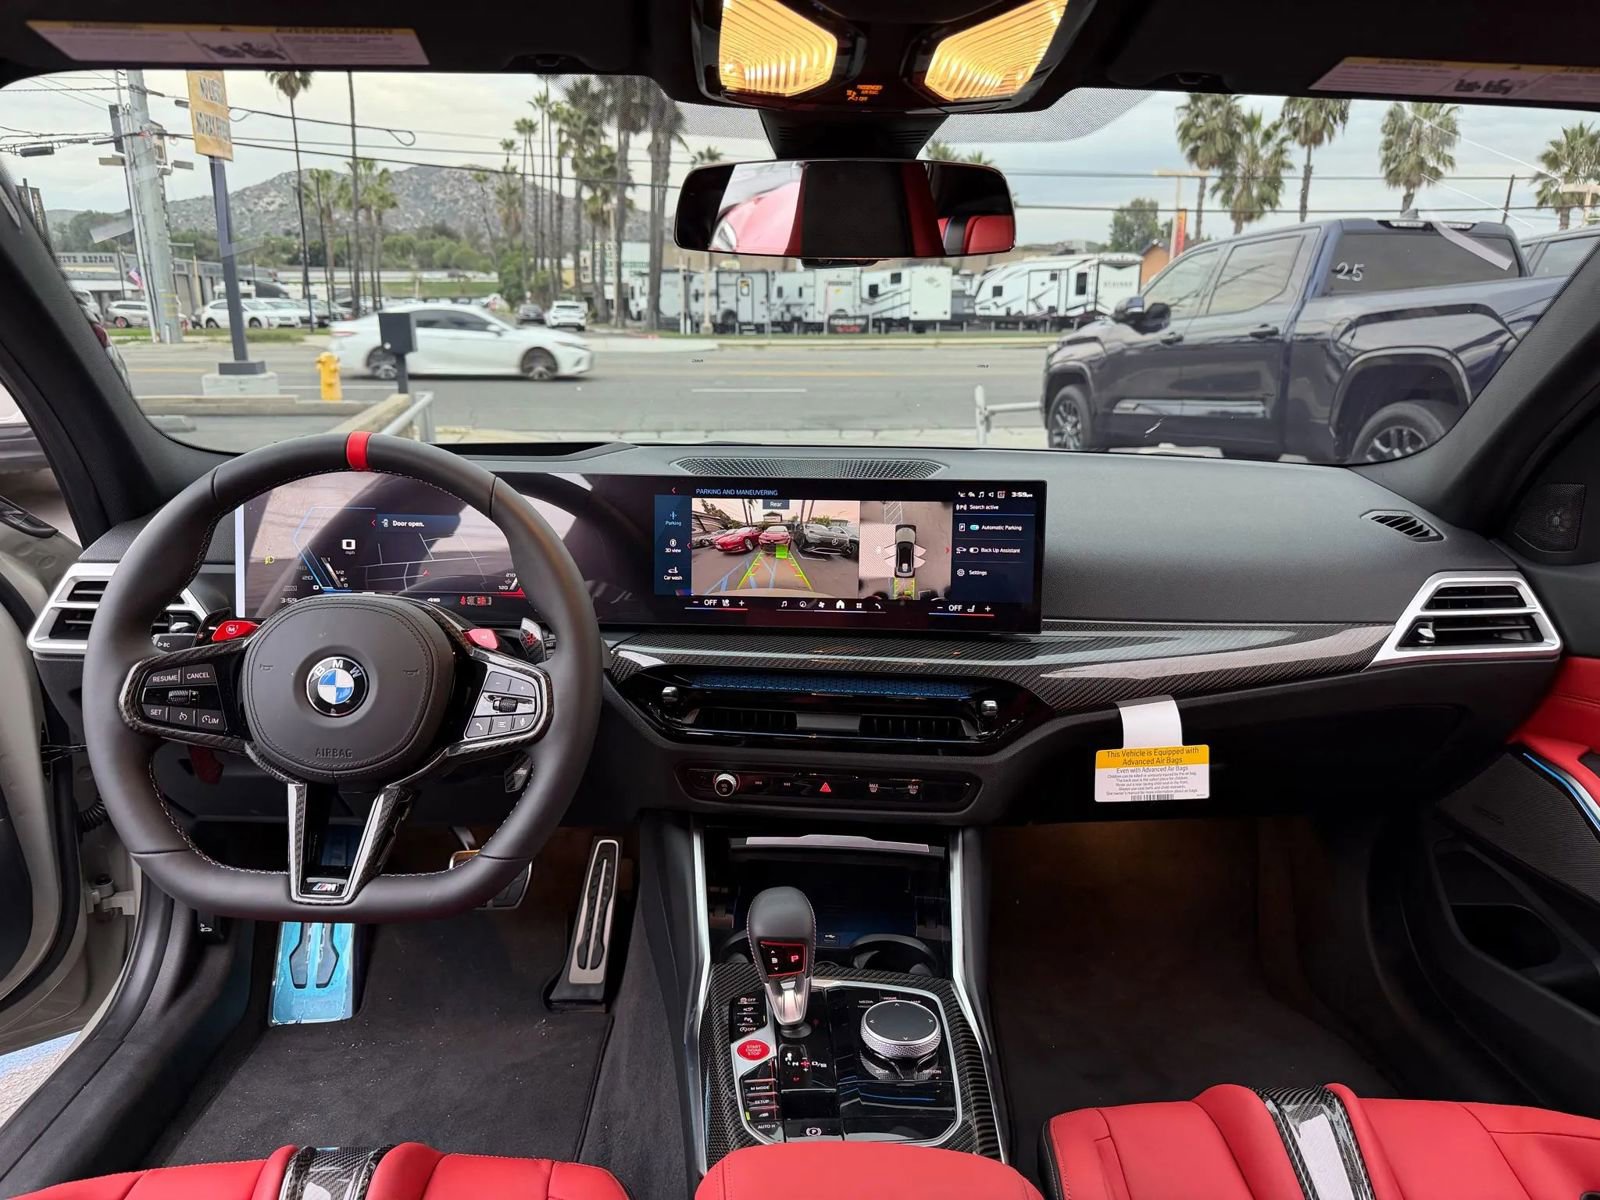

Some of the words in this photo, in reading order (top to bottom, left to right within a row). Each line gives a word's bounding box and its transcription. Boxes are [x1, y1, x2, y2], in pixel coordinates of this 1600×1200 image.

[82, 255, 114, 263] REPAIR
[1335, 261, 1365, 281] 25
[342, 539, 356, 550] 0
[948, 604, 963, 612] OFF
[314, 659, 363, 678] BMW
[152, 674, 178, 683] RESUME
[186, 671, 210, 680] CANCEL
[315, 747, 353, 759] AIRBAG
[1121, 750, 1146, 758] Vehicle
[1153, 748, 1185, 758] Equipped
[1122, 758, 1154, 766] Advanced
[1166, 757, 1183, 765] Bags
[791, 955, 799, 963] P
